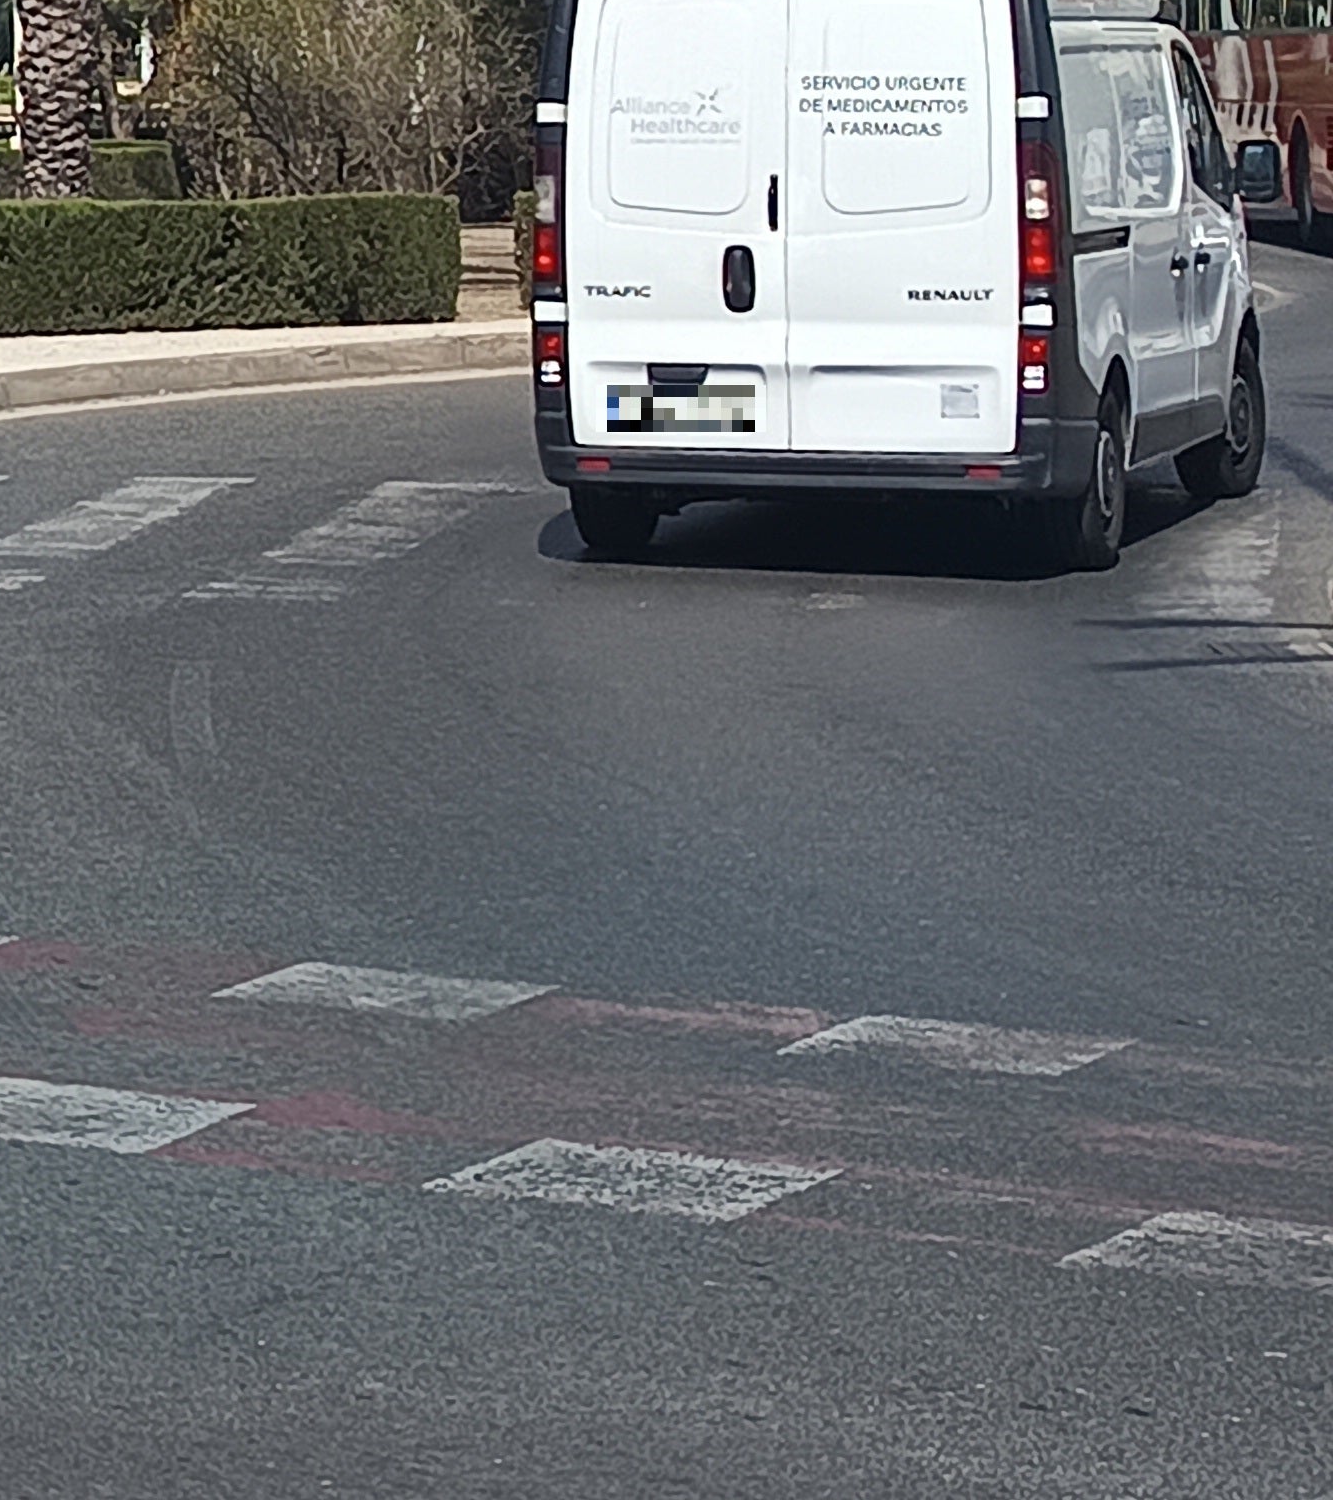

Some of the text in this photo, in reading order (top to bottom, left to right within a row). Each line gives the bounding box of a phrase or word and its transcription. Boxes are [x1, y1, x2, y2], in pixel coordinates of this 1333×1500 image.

[801, 76, 967, 91] SERVICIO URGENTE
[610, 97, 691, 115] Alliance
[799, 98, 969, 114] DE MEDICAMENTOS
[630, 118, 741, 134] Healthcare
[823, 121, 943, 137] A FARMACIAS
[583, 285, 652, 298] TRAFIC
[907, 288, 995, 301] RENAULT
